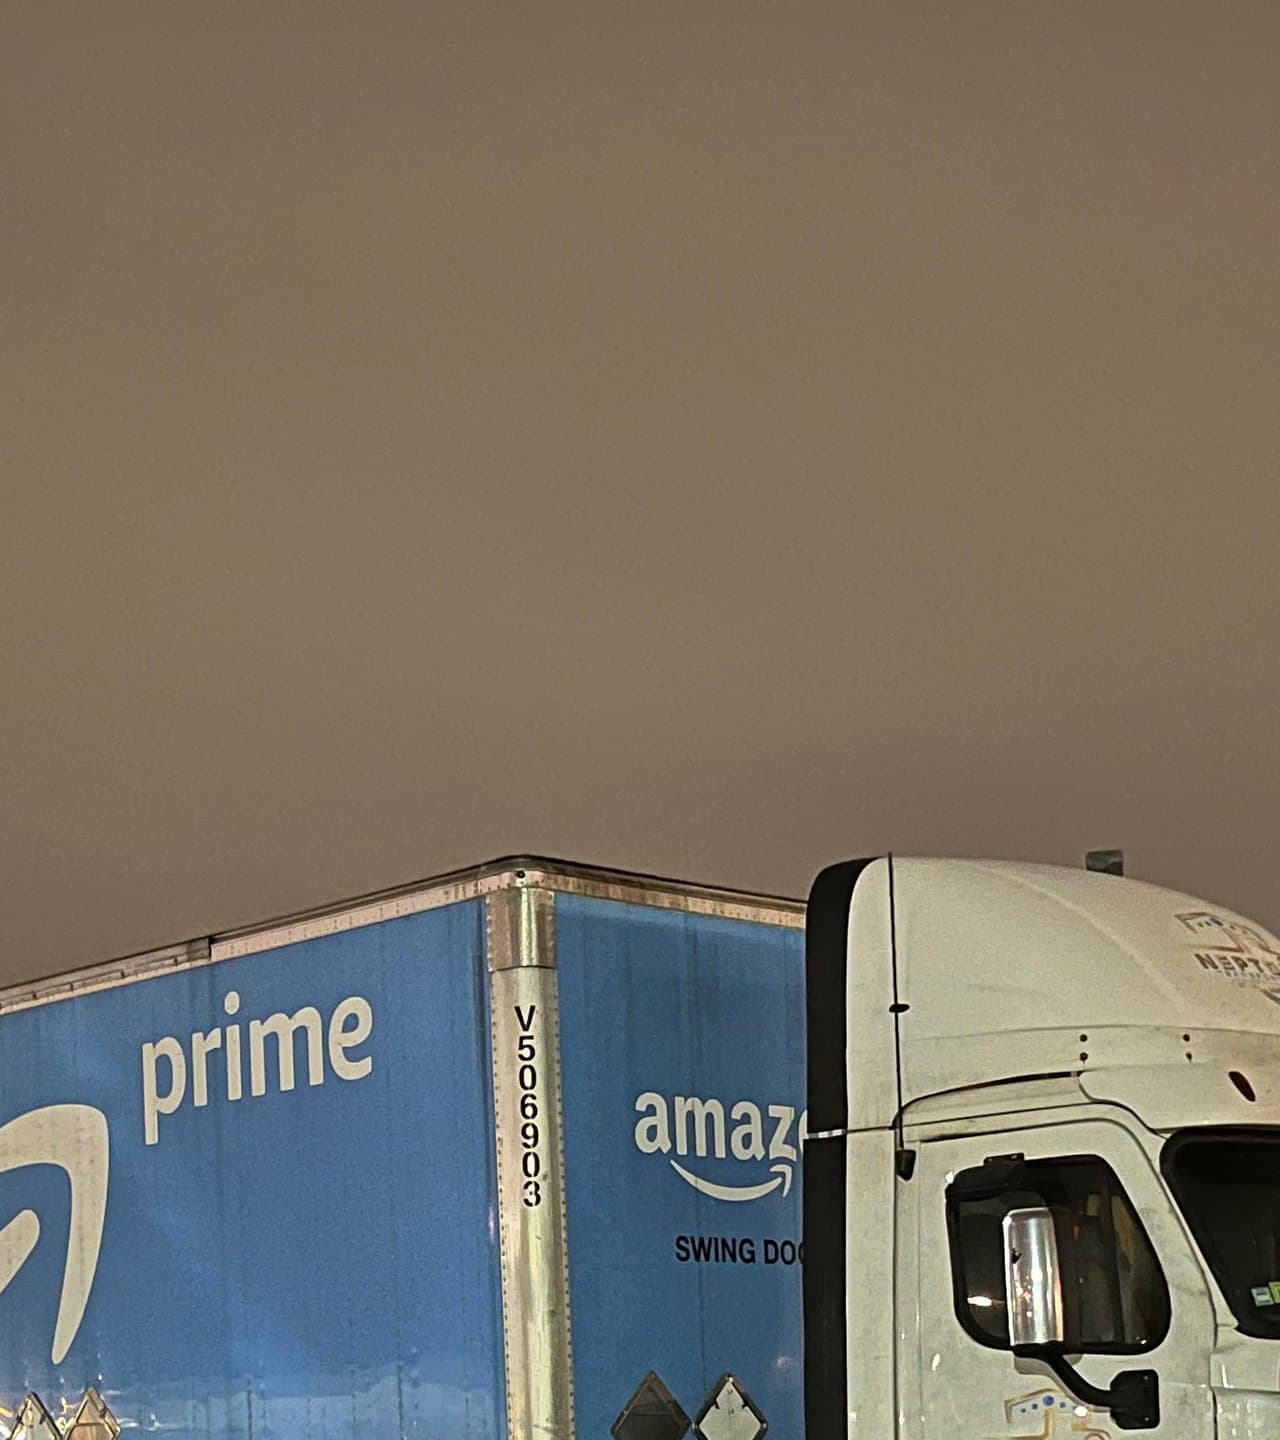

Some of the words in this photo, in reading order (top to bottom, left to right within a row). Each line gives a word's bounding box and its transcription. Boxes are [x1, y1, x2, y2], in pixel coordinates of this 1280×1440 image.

[141, 990, 373, 1146] prime
[514, 1005, 541, 1207] V506903
[634, 1091, 808, 1161] amaz
[675, 1235, 756, 1264] SWING
